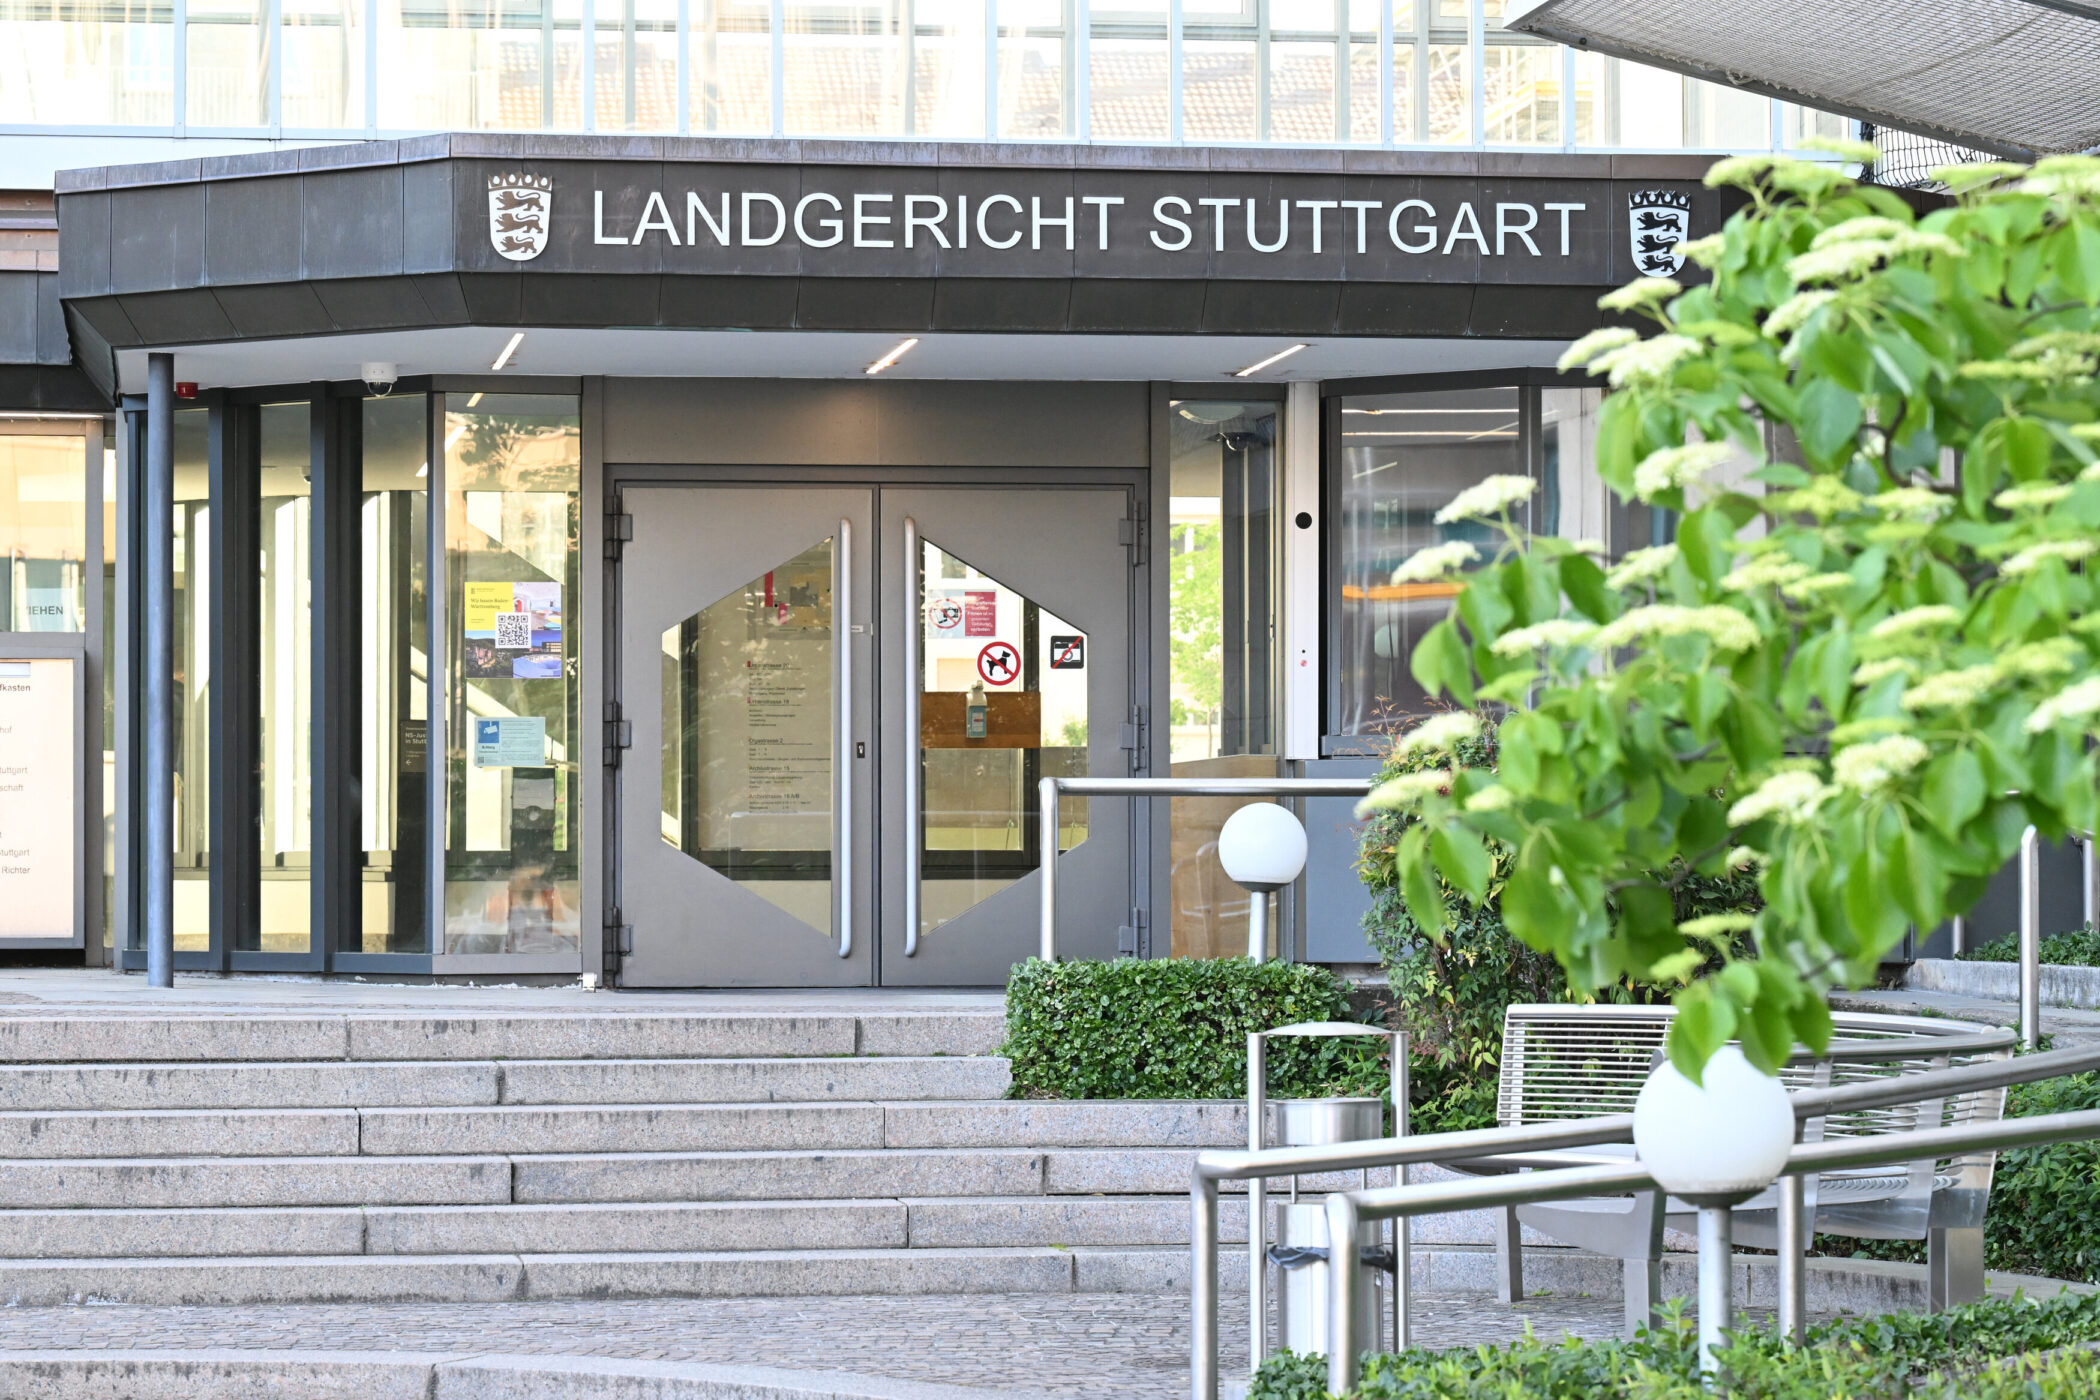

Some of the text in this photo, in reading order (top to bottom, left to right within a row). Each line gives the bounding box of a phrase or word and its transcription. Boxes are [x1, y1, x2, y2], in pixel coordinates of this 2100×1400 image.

[594, 191, 1586, 256] LANDGERICHT STUTTGART
[27, 605, 64, 615] IEHEN
